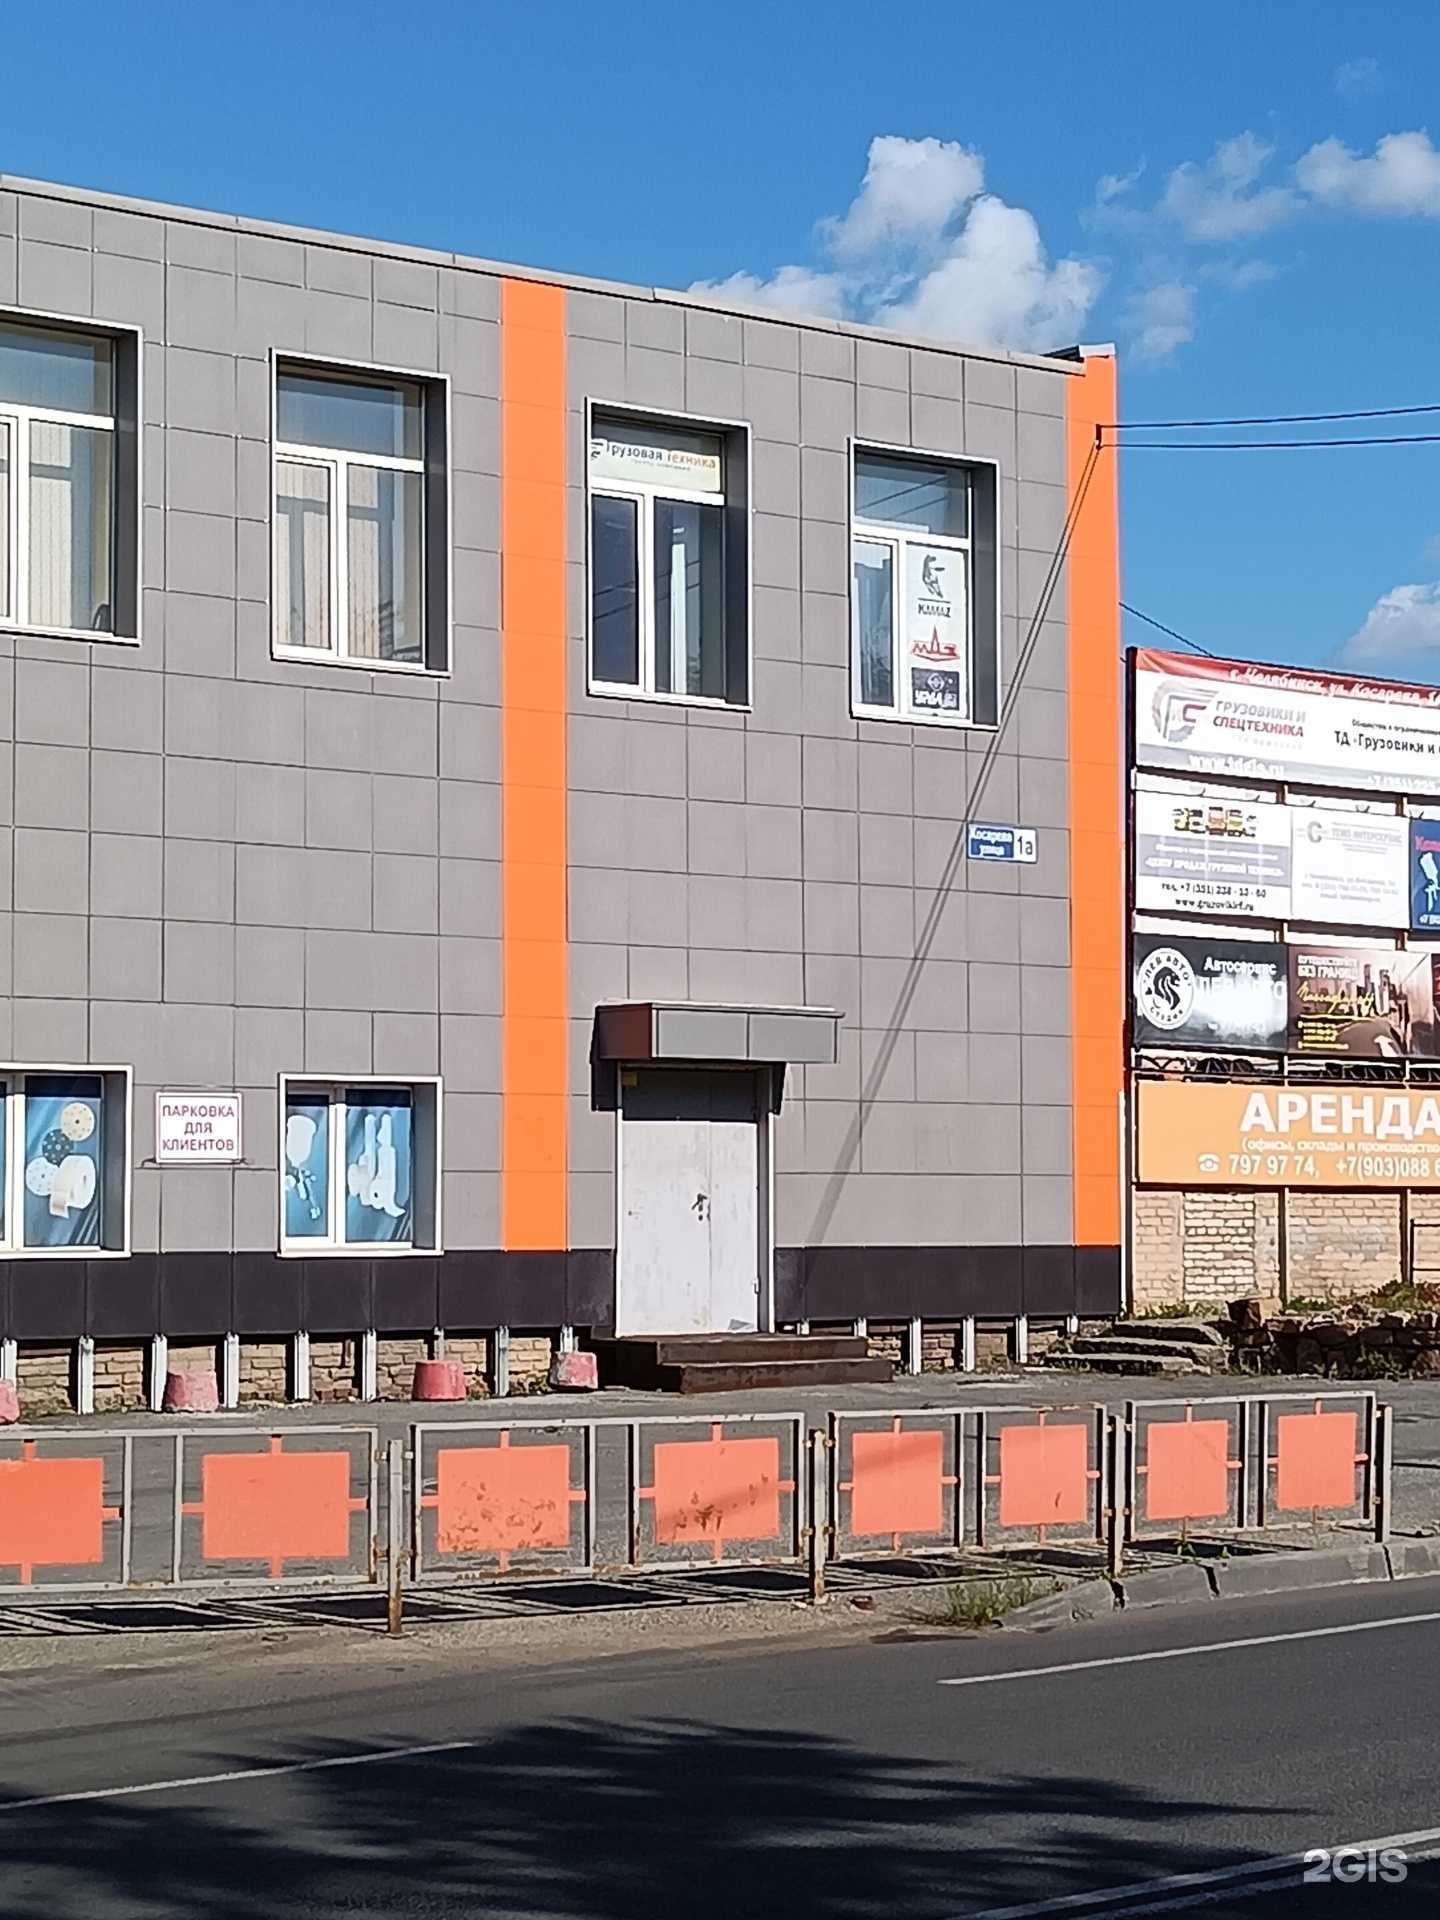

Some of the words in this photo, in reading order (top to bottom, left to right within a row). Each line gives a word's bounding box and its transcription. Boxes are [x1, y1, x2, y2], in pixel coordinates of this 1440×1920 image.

[1216, 700, 1295, 722] ГРУЗОВИКИ
[1213, 715, 1304, 737] СПЕЦТЕХНИКА
[162, 1104, 235, 1118] ПАРКОВКА
[1240, 1092, 1440, 1140] АРЕНДА
[184, 1121, 213, 1136] ДЛЯ
[162, 1138, 235, 1152] КЛИЕНТОВ
[1297, 1140, 1345, 1153] склады
[1229, 1154, 1262, 1176] 797
[1267, 1155, 1289, 1177] 97
[1336, 1156, 1431, 1182] +7(903)088
